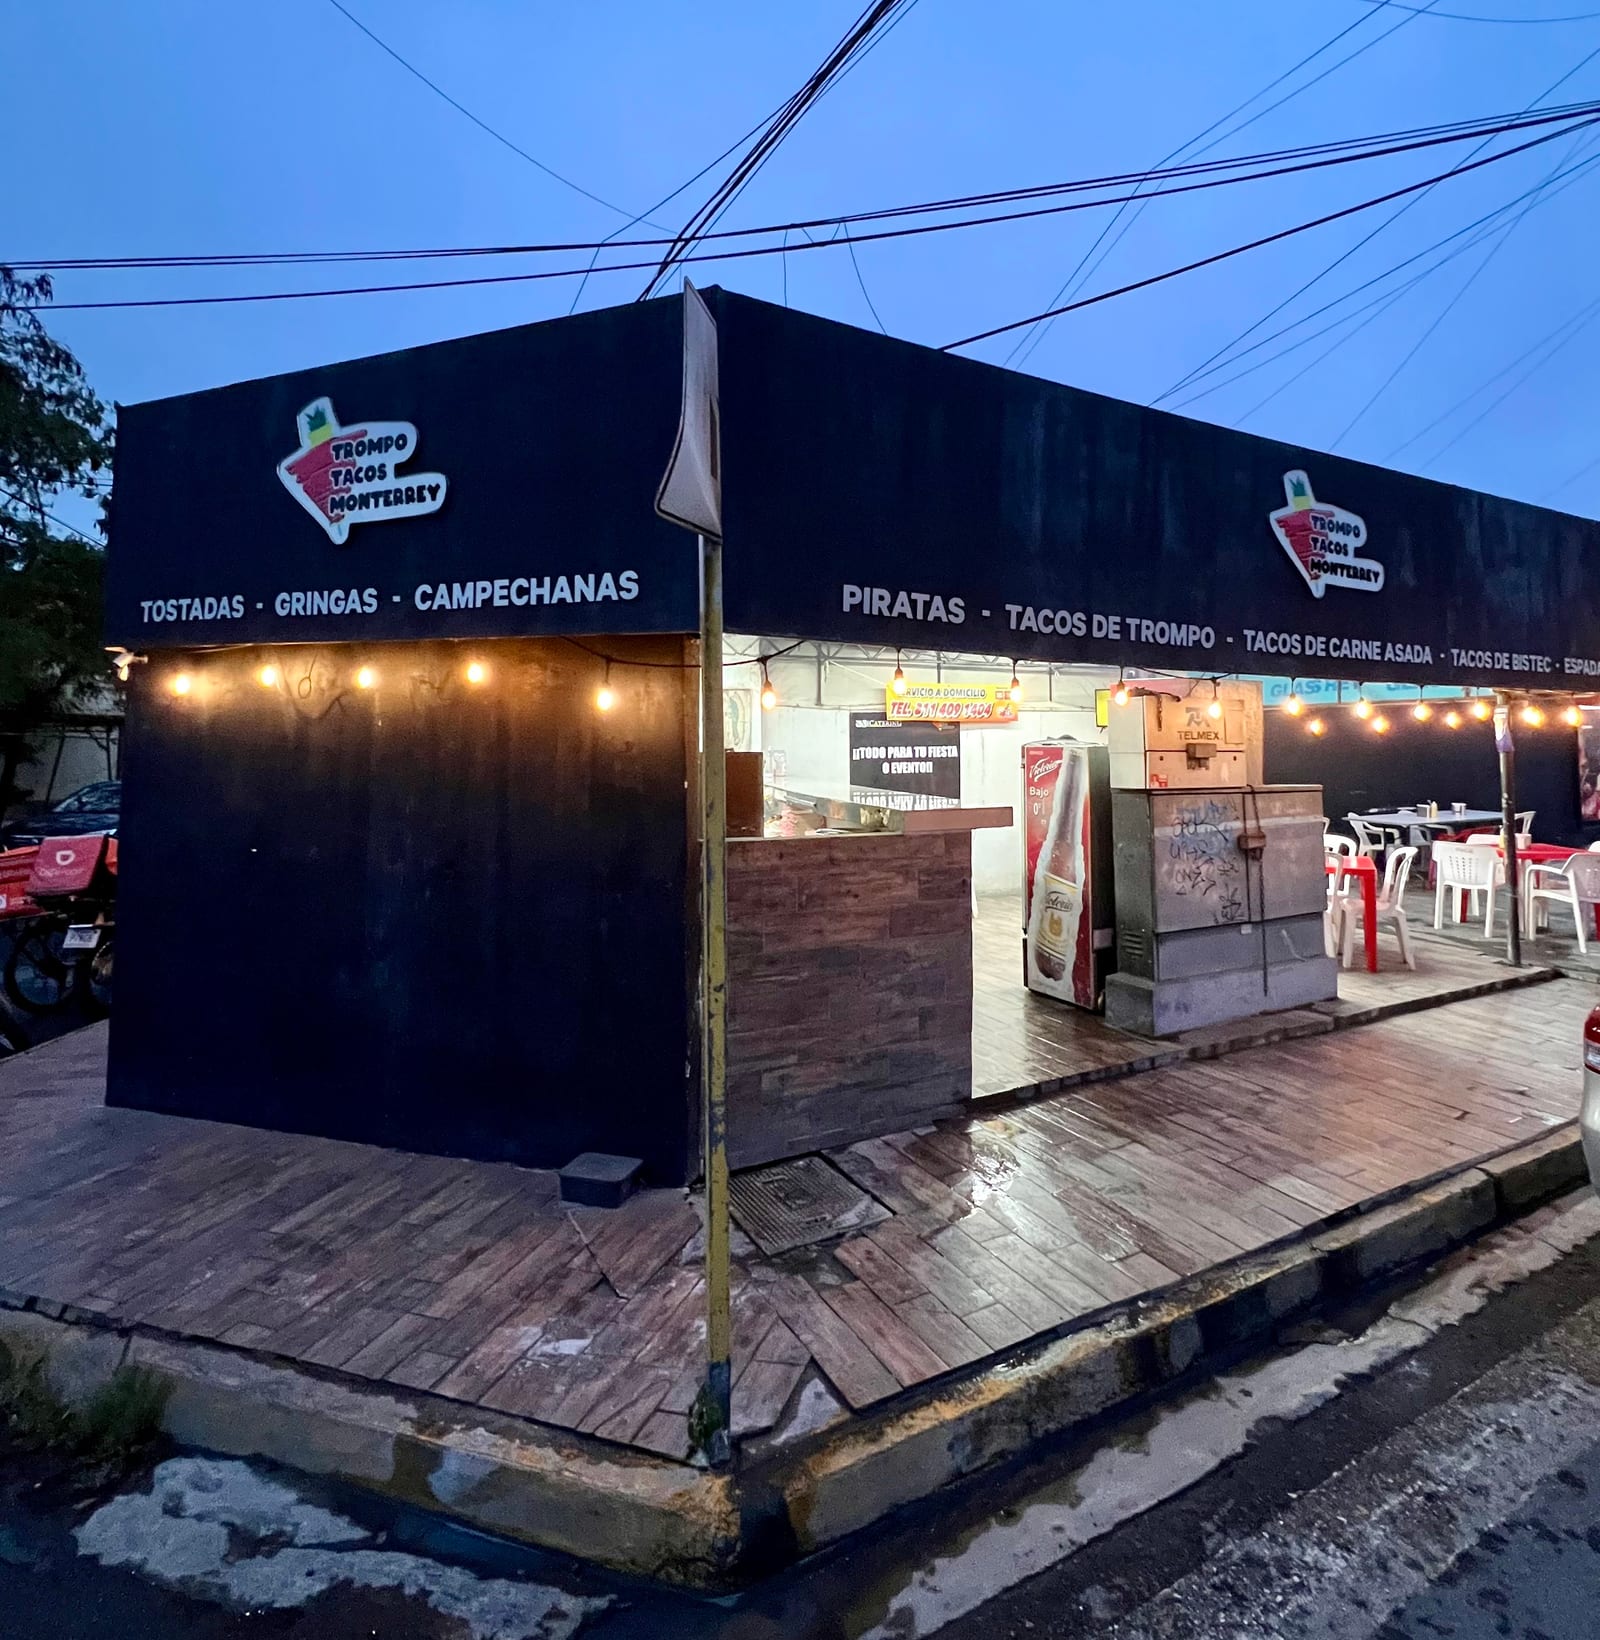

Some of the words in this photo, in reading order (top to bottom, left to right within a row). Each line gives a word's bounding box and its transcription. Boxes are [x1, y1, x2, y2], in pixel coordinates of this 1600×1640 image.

[331, 433, 408, 461] TROMPO
[331, 463, 387, 487] TACOS
[329, 483, 441, 514] MONTERREY
[1311, 515, 1361, 538] TROMPO
[1311, 536, 1349, 557] TACOS
[1310, 558, 1380, 583] MONTERREY
[140, 595, 245, 623] TOSTADAS
[274, 588, 378, 616] GRINGAS
[414, 570, 639, 611] CAMPECHANAS
[842, 584, 966, 624] PIRATAS
[1005, 604, 1088, 637] TACOS
[1092, 614, 1122, 640] DE
[1125, 618, 1216, 649] TROMPO
[1243, 629, 1302, 655] TACOS
[1305, 635, 1327, 657] DE
[1329, 637, 1382, 661] CARNE
[1384, 642, 1433, 664] ASADA
[1450, 649, 1493, 669] TACOS
[1494, 652, 1511, 670] DE
[1511, 653, 1552, 673] BISTEC
[939, 703, 963, 717] 409
[1177, 730, 1220, 741] TELMEX
[887, 746, 913, 759] PARA
[913, 745, 927, 758] TU
[927, 745, 958, 758] FIESTA
[881, 761, 890, 774] O
[1029, 786, 1049, 799] Bajo
